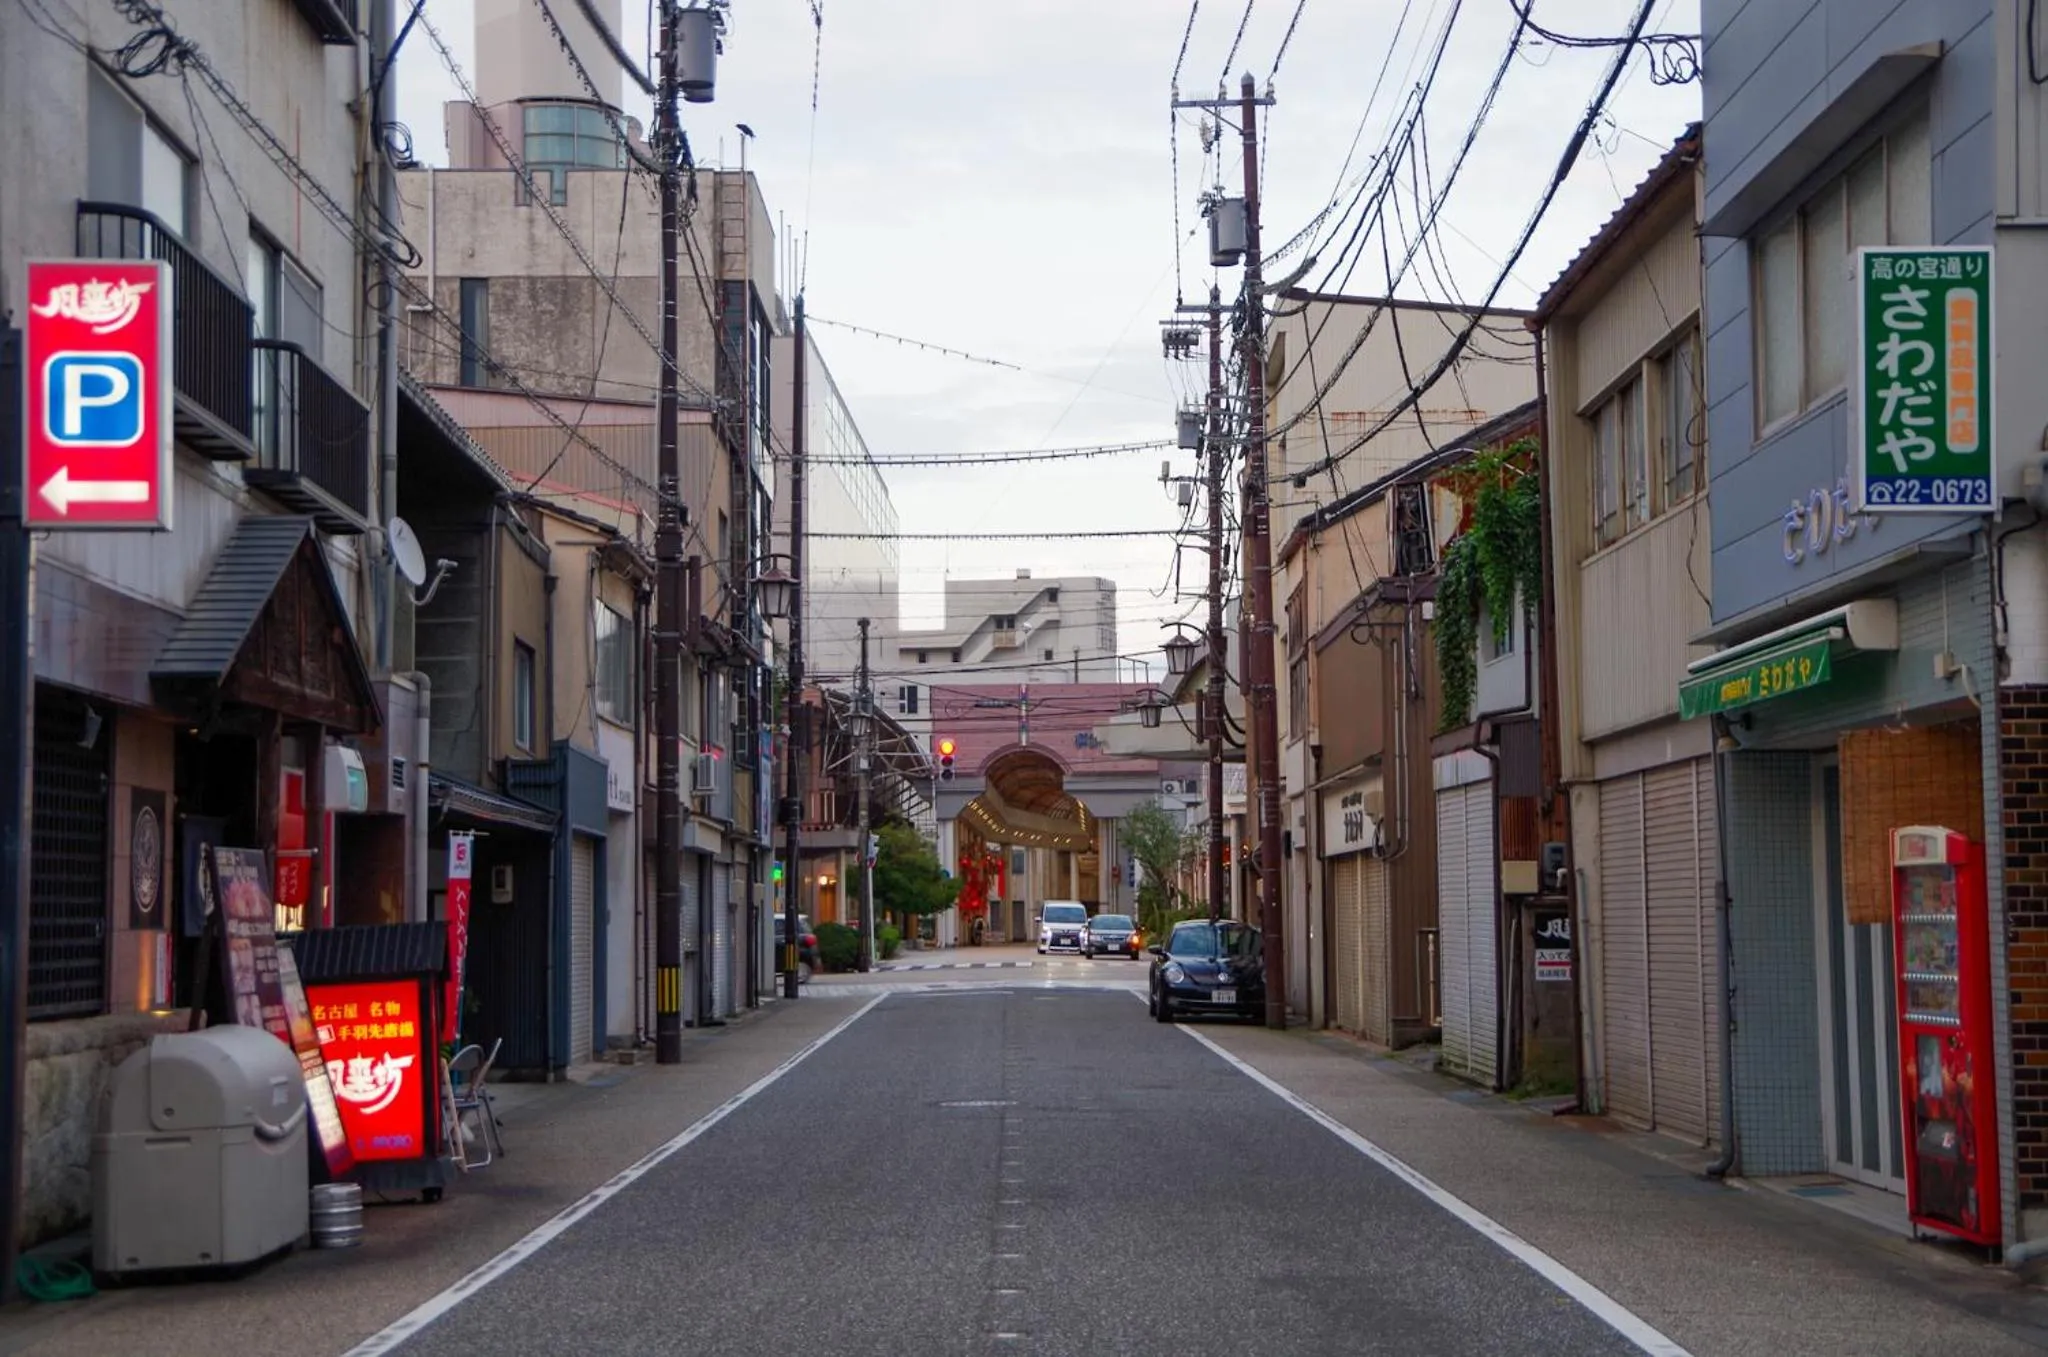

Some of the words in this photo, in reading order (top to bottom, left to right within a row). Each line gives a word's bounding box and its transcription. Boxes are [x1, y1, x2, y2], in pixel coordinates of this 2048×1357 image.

[1871, 256, 1983, 280] 高の宮通り
[1875, 283, 1937, 473] さわだや
[63, 363, 130, 436] P
[1894, 478, 1988, 503] 22-0673
[312, 1003, 358, 1020] 名古屋
[370, 1000, 400, 1017] 名物
